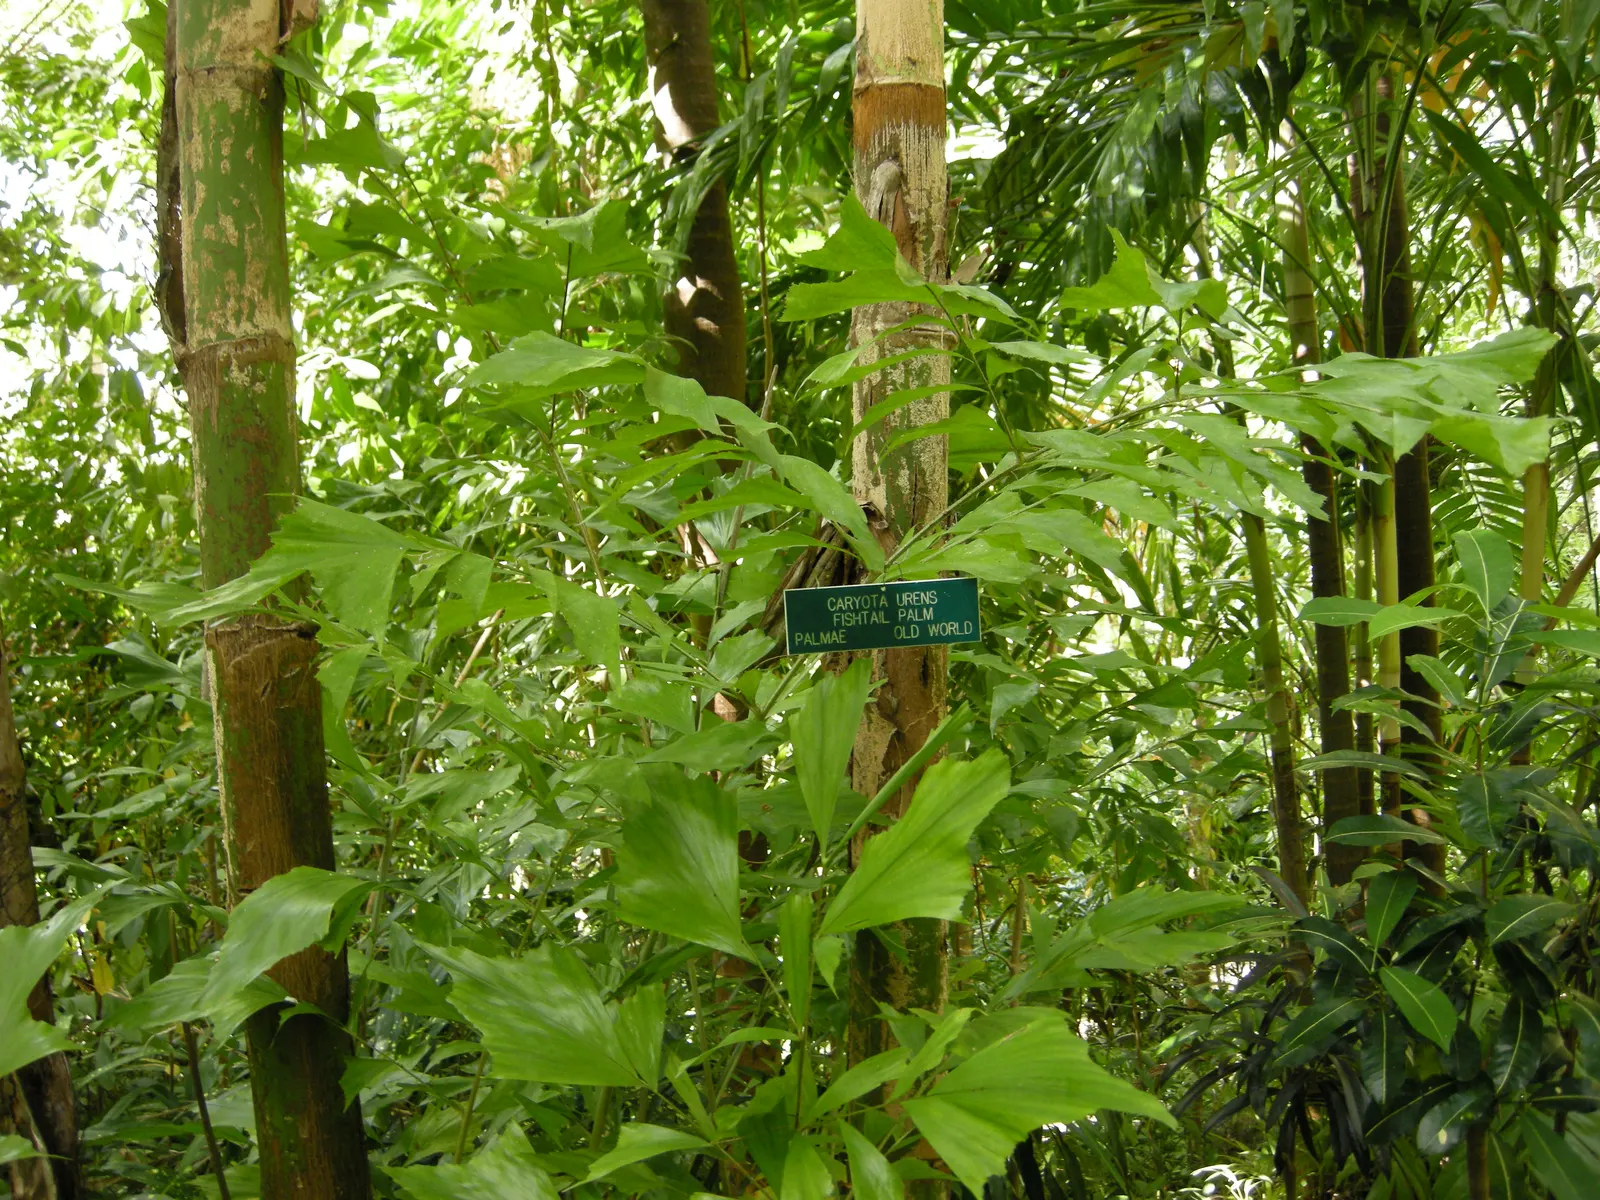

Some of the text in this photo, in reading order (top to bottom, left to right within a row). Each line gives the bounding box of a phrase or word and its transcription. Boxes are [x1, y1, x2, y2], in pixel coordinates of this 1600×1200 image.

[827, 591, 938, 612] CARYOTA URENS
[833, 608, 934, 627] FISHTAIL PALM
[794, 621, 973, 646] PALMAE OLD WORLD
